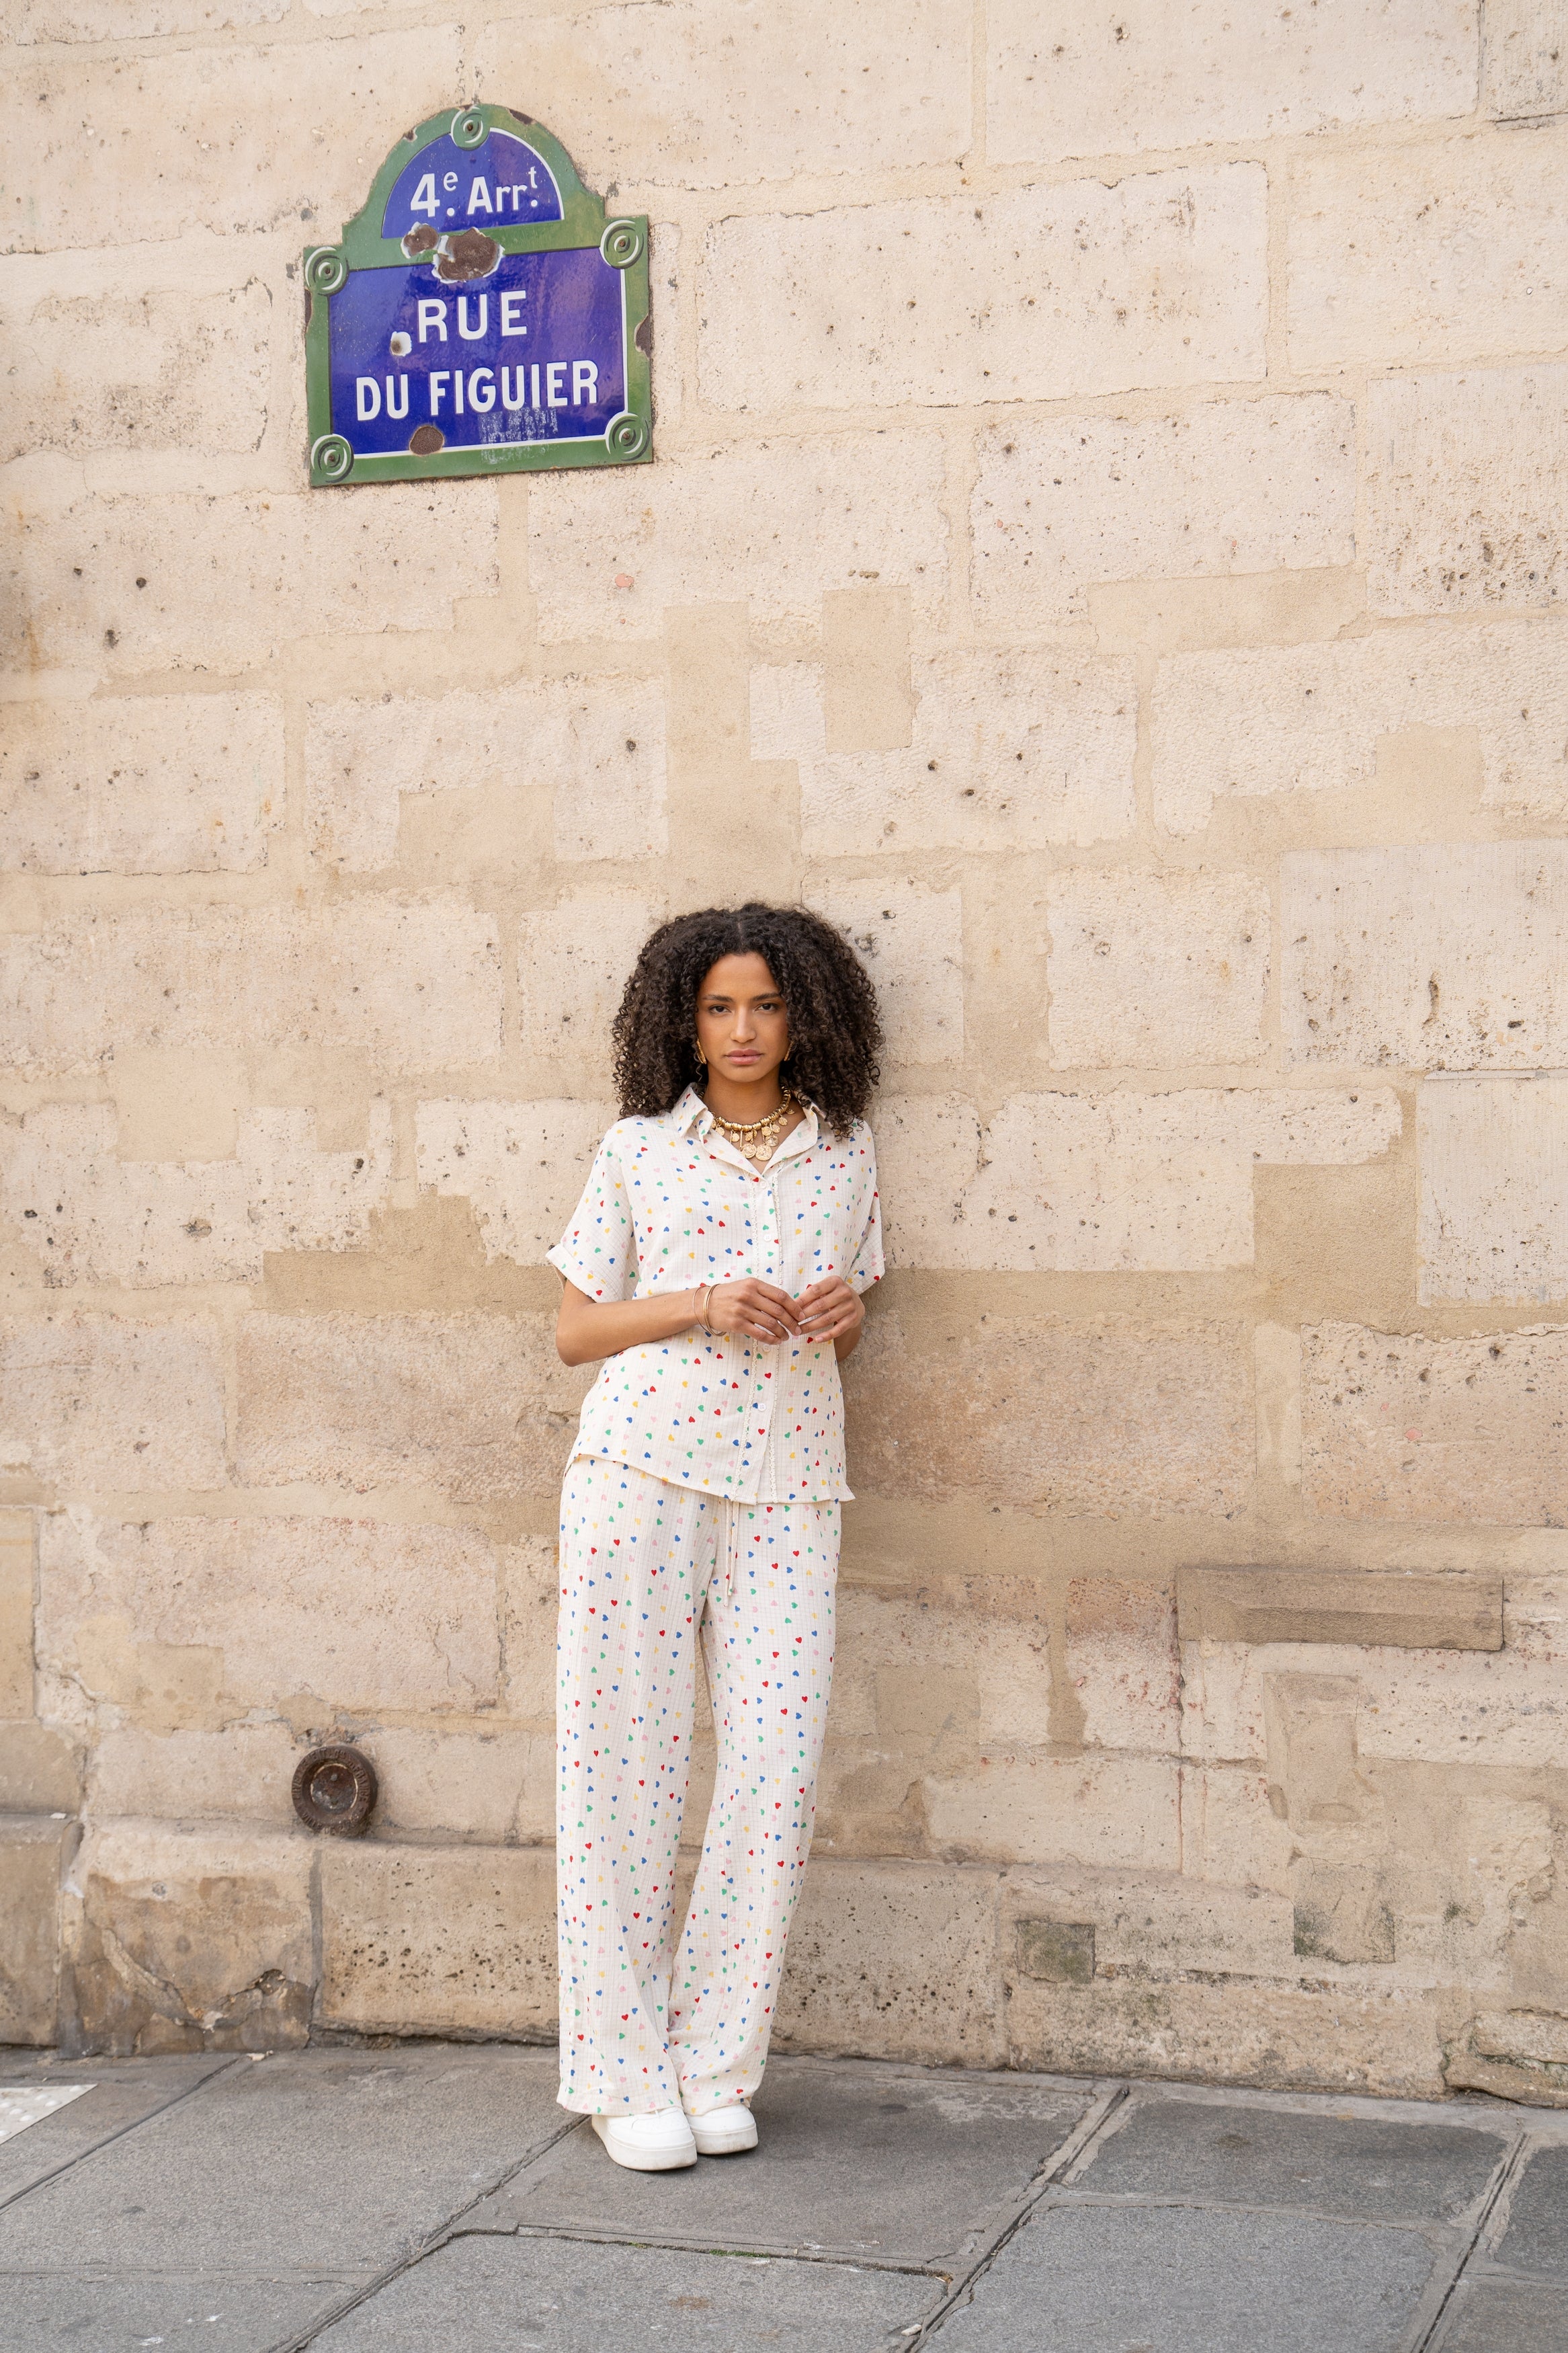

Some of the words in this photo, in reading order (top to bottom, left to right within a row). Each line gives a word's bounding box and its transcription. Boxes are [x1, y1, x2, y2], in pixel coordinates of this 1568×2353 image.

[417, 290, 527, 343] RUE
[356, 374, 409, 421] DU
[429, 360, 598, 416] FIGUIER
